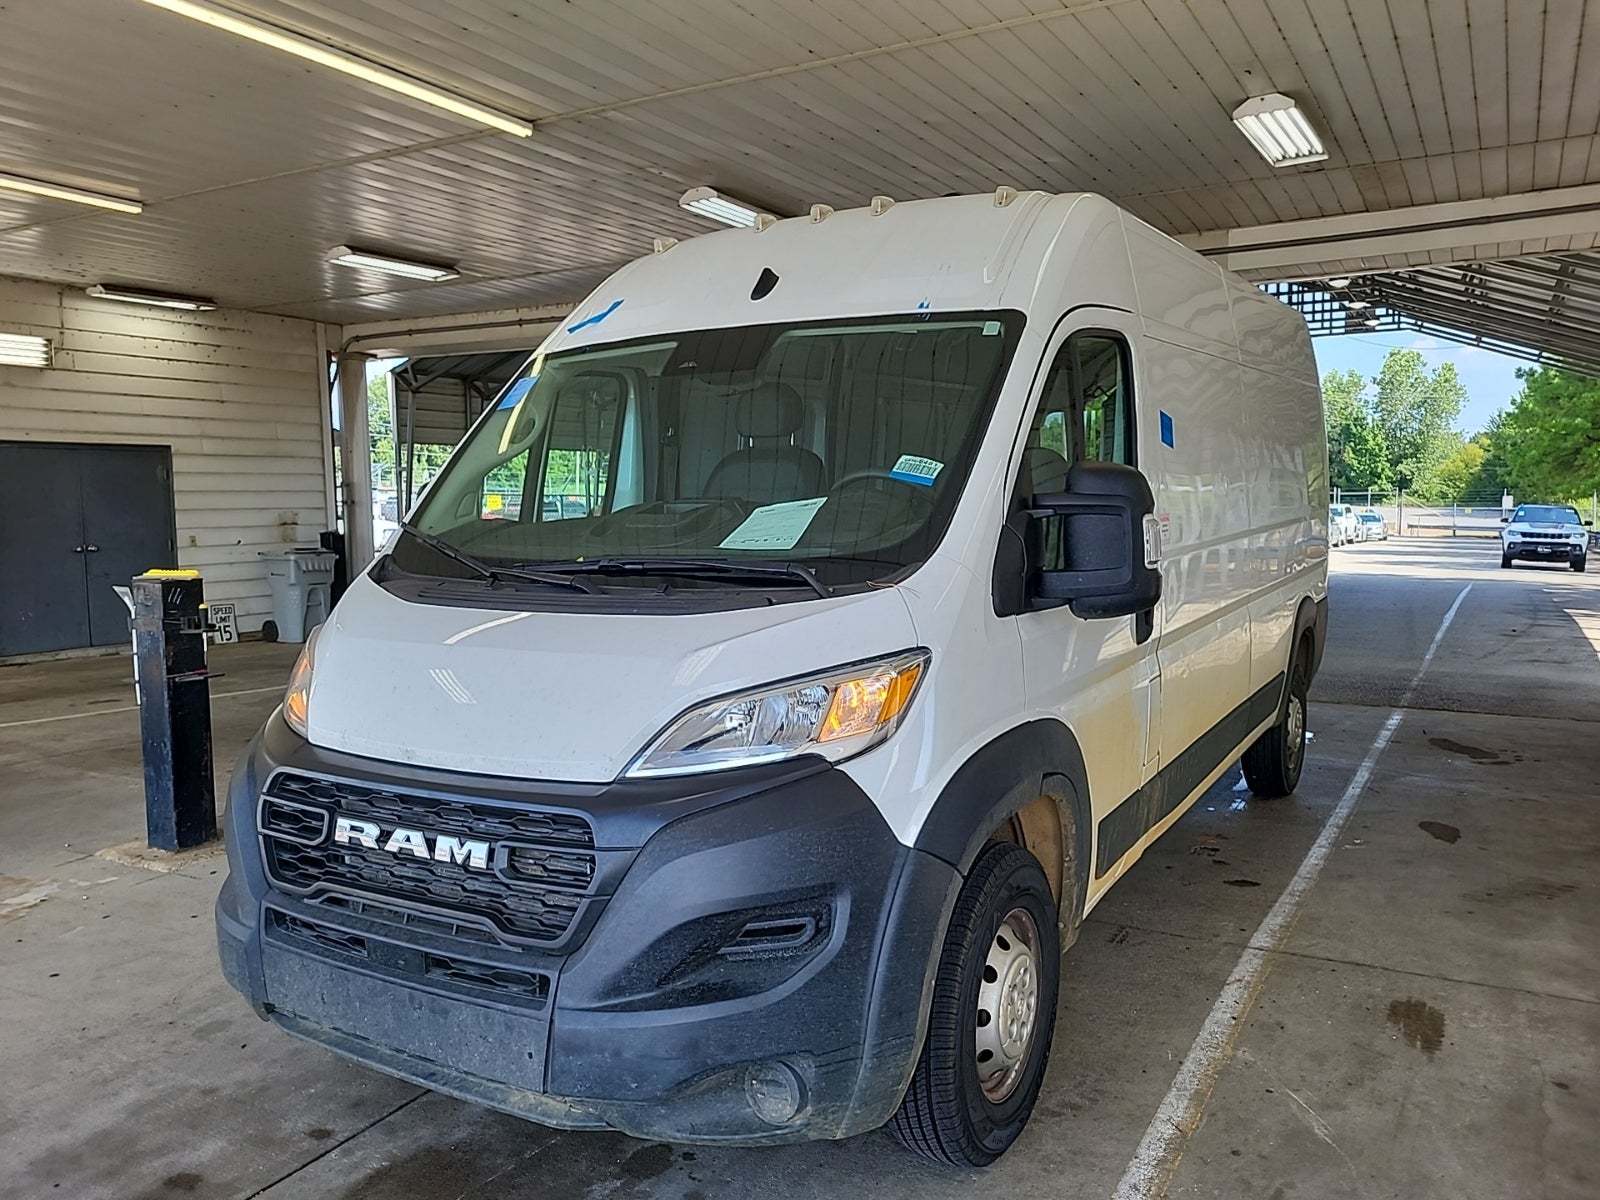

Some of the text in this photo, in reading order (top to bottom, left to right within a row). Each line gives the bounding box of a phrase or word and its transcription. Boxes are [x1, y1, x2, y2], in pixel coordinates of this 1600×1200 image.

[213, 606, 233, 616] SPEED
[216, 615, 231, 624] LIMIT
[218, 624, 233, 642] 15
[334, 816, 491, 870] RAM
